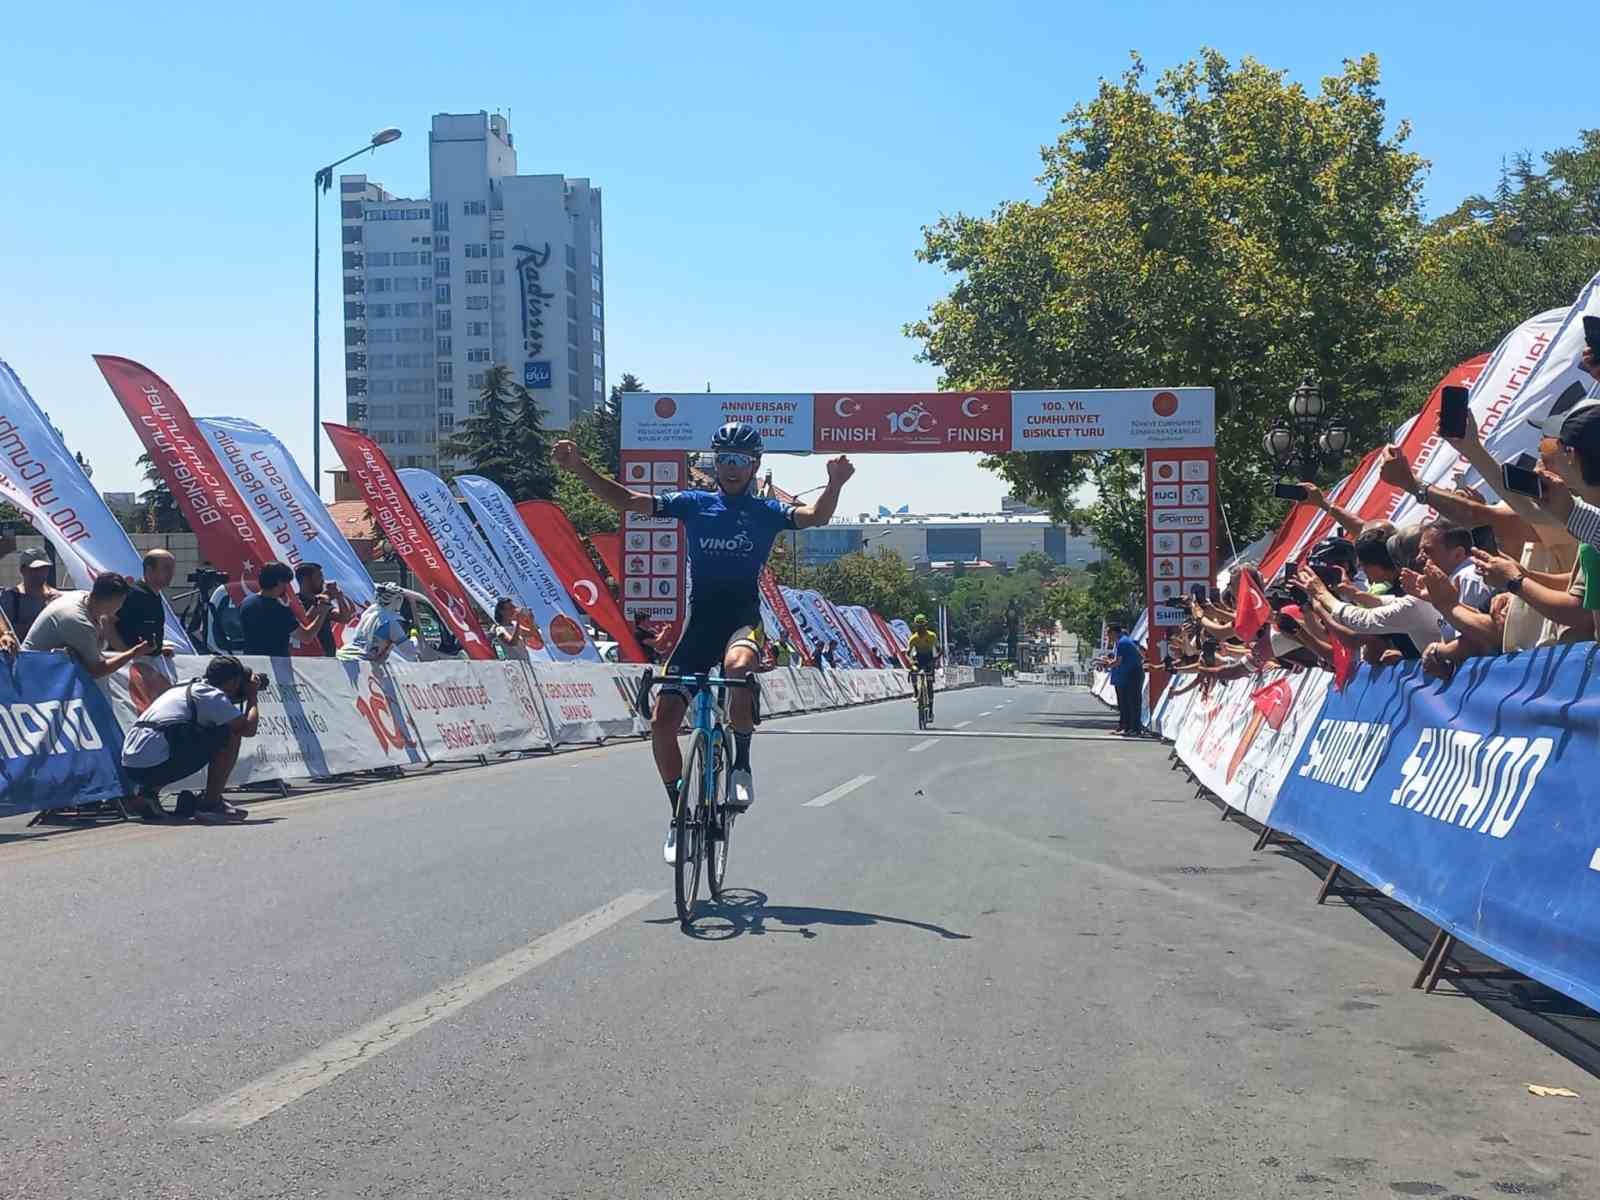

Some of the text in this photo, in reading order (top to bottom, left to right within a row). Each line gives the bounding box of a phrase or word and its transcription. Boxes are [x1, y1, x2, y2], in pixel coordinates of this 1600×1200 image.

[511, 241, 555, 358] Radisson
[720, 401, 798, 412] ANNIVERSARY
[1042, 401, 1065, 411] 100.
[725, 415, 794, 425] TOUR OF THE
[820, 427, 876, 441] FINISH
[947, 427, 1004, 441] FINISH
[1074, 426, 1105, 438] TURU
[1158, 491, 1177, 500] UCI
[699, 537, 737, 550] VINO
[1298, 718, 1391, 793] SHIMANO
[1389, 727, 1554, 839] SHIMANO
